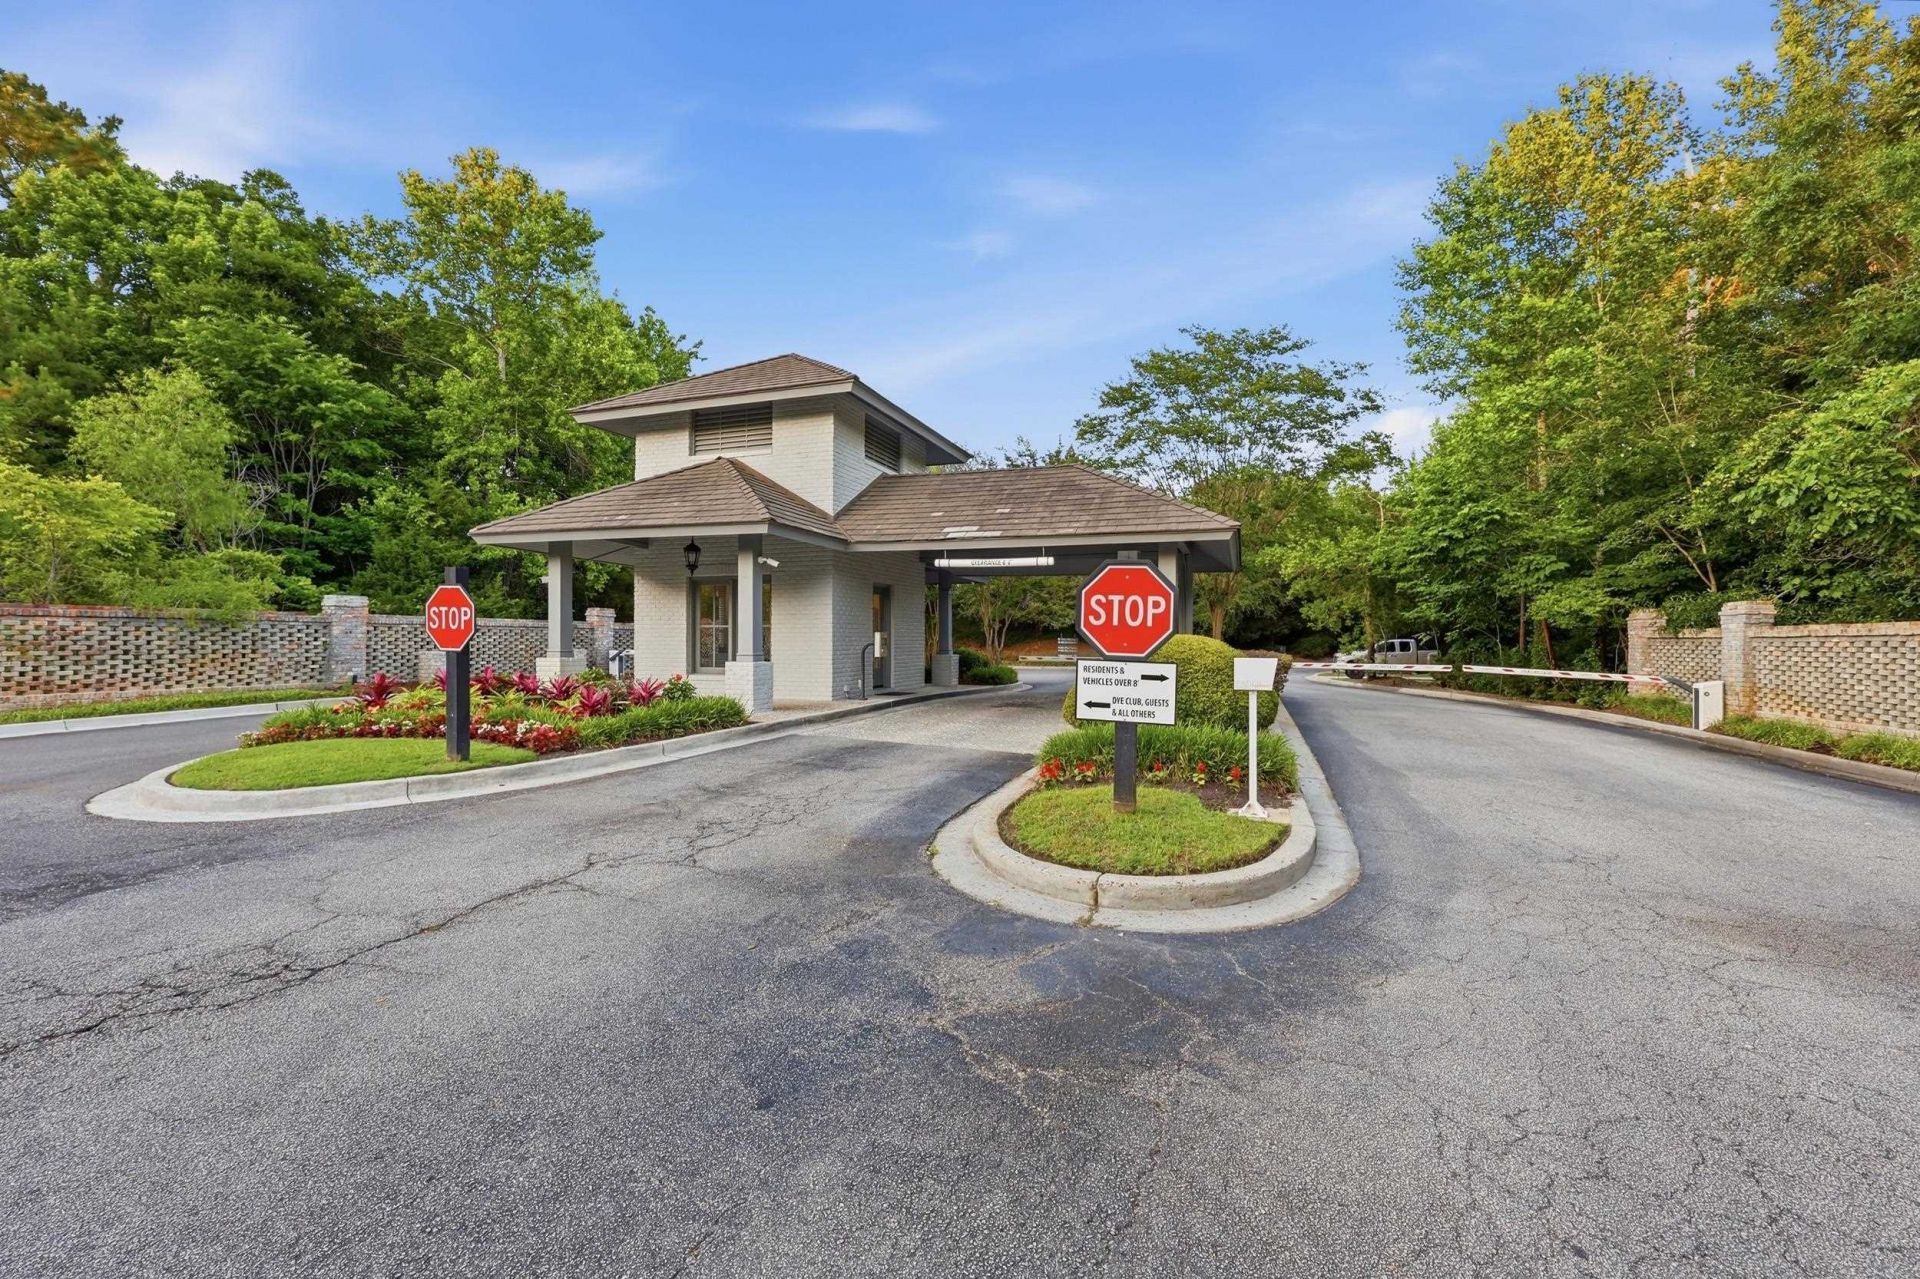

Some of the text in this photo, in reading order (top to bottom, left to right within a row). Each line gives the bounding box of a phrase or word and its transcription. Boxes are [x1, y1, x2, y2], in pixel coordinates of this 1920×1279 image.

[1088, 594, 1166, 627] STOP
[429, 606, 471, 630] STOP
[1083, 665, 1125, 675] RESIDENTS &
[1083, 677, 1113, 686] VEHICLES
[1114, 679, 1132, 687] OVER
[1112, 696, 1170, 707] DYE CLUB, GUESTS
[1111, 708, 1156, 719] & ALL OTHERS
